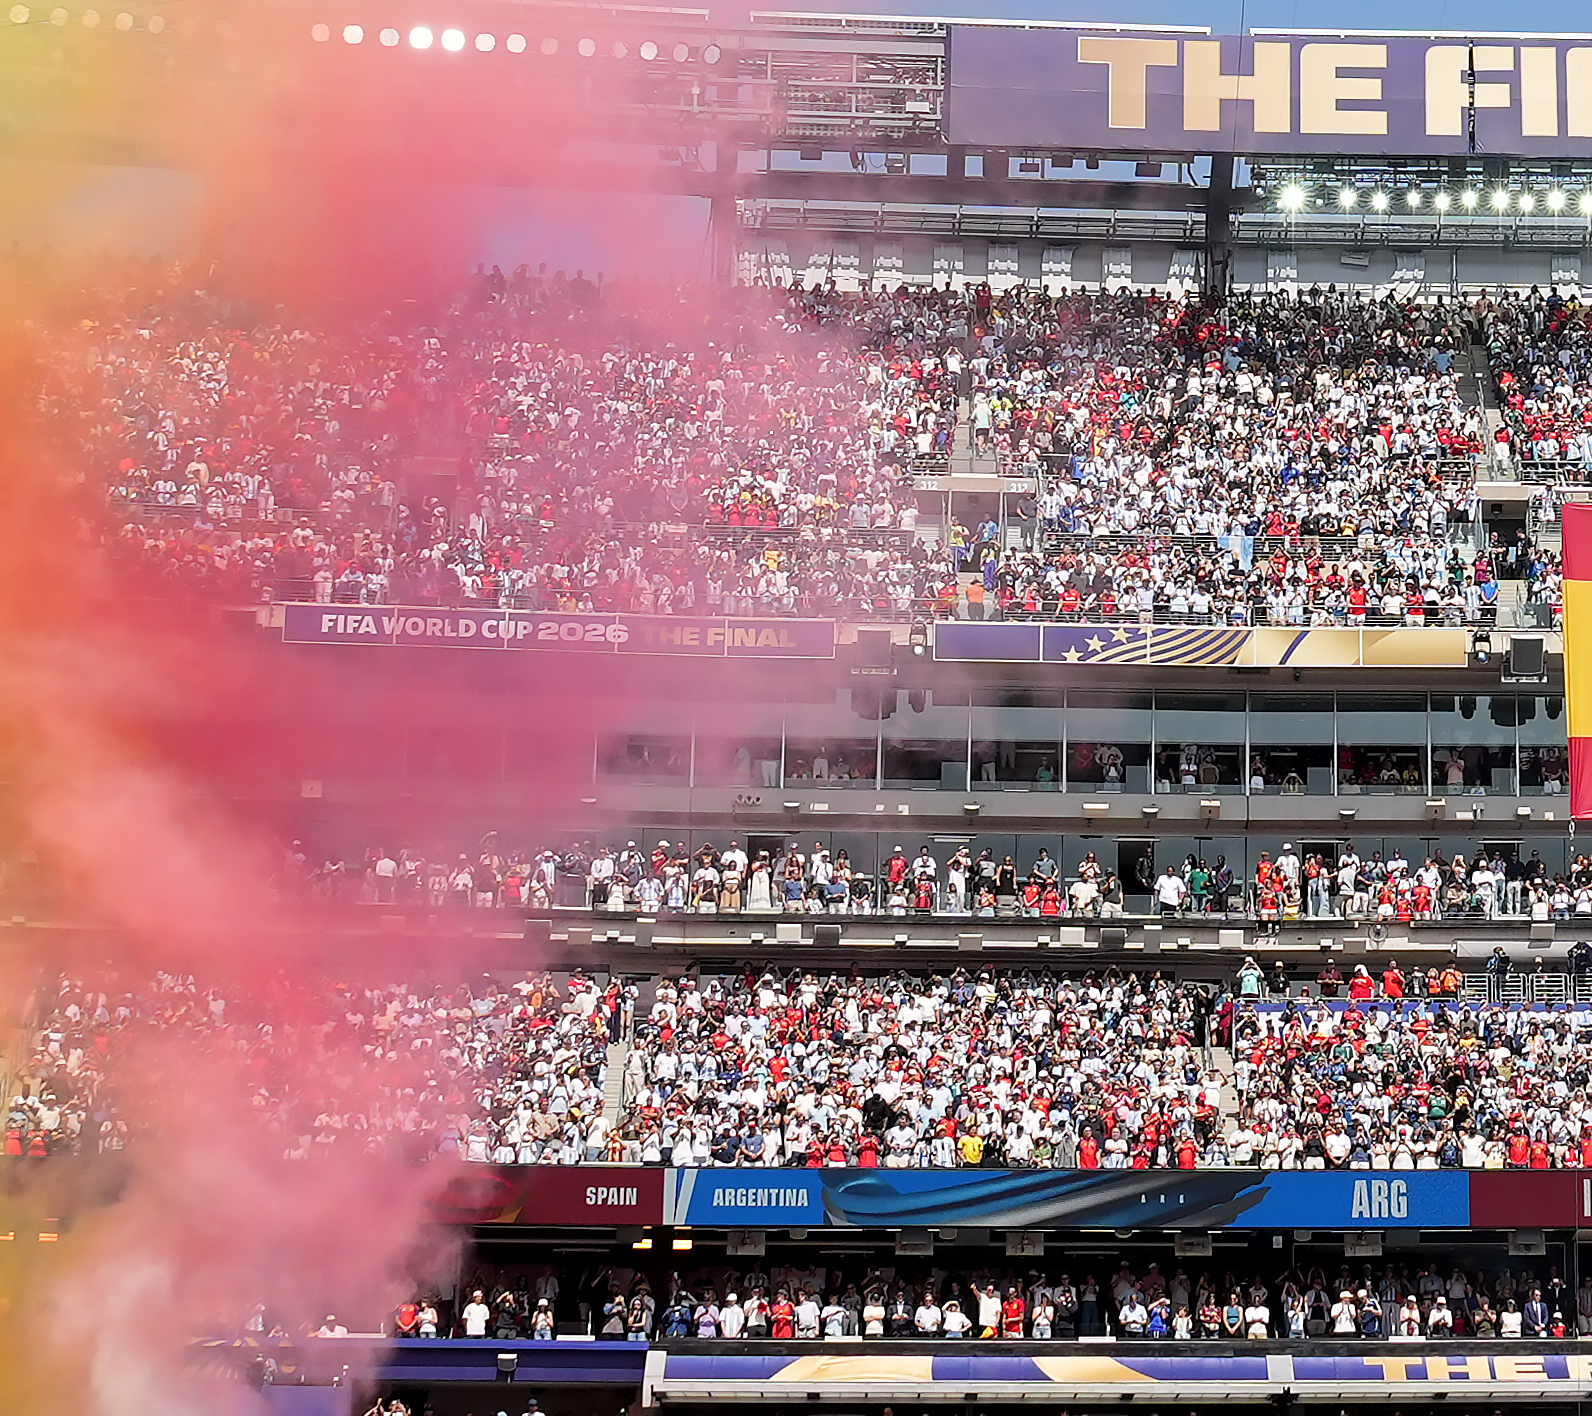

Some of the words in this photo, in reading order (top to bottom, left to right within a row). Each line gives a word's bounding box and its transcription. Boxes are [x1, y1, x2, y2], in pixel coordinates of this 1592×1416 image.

[1076, 36, 1388, 135] THE
[920, 480, 939, 491] 312
[320, 614, 378, 636] FIFA
[382, 617, 478, 639] WORLD
[481, 620, 534, 641] CUP
[536, 621, 630, 644] 2026
[641, 624, 700, 647] THE
[706, 626, 797, 649] FINAL
[585, 1186, 638, 1206] SPAIN
[712, 1187, 809, 1207] ARGENTINA
[1351, 1178, 1408, 1219] ARG
[1363, 1356, 1546, 1382] THE
